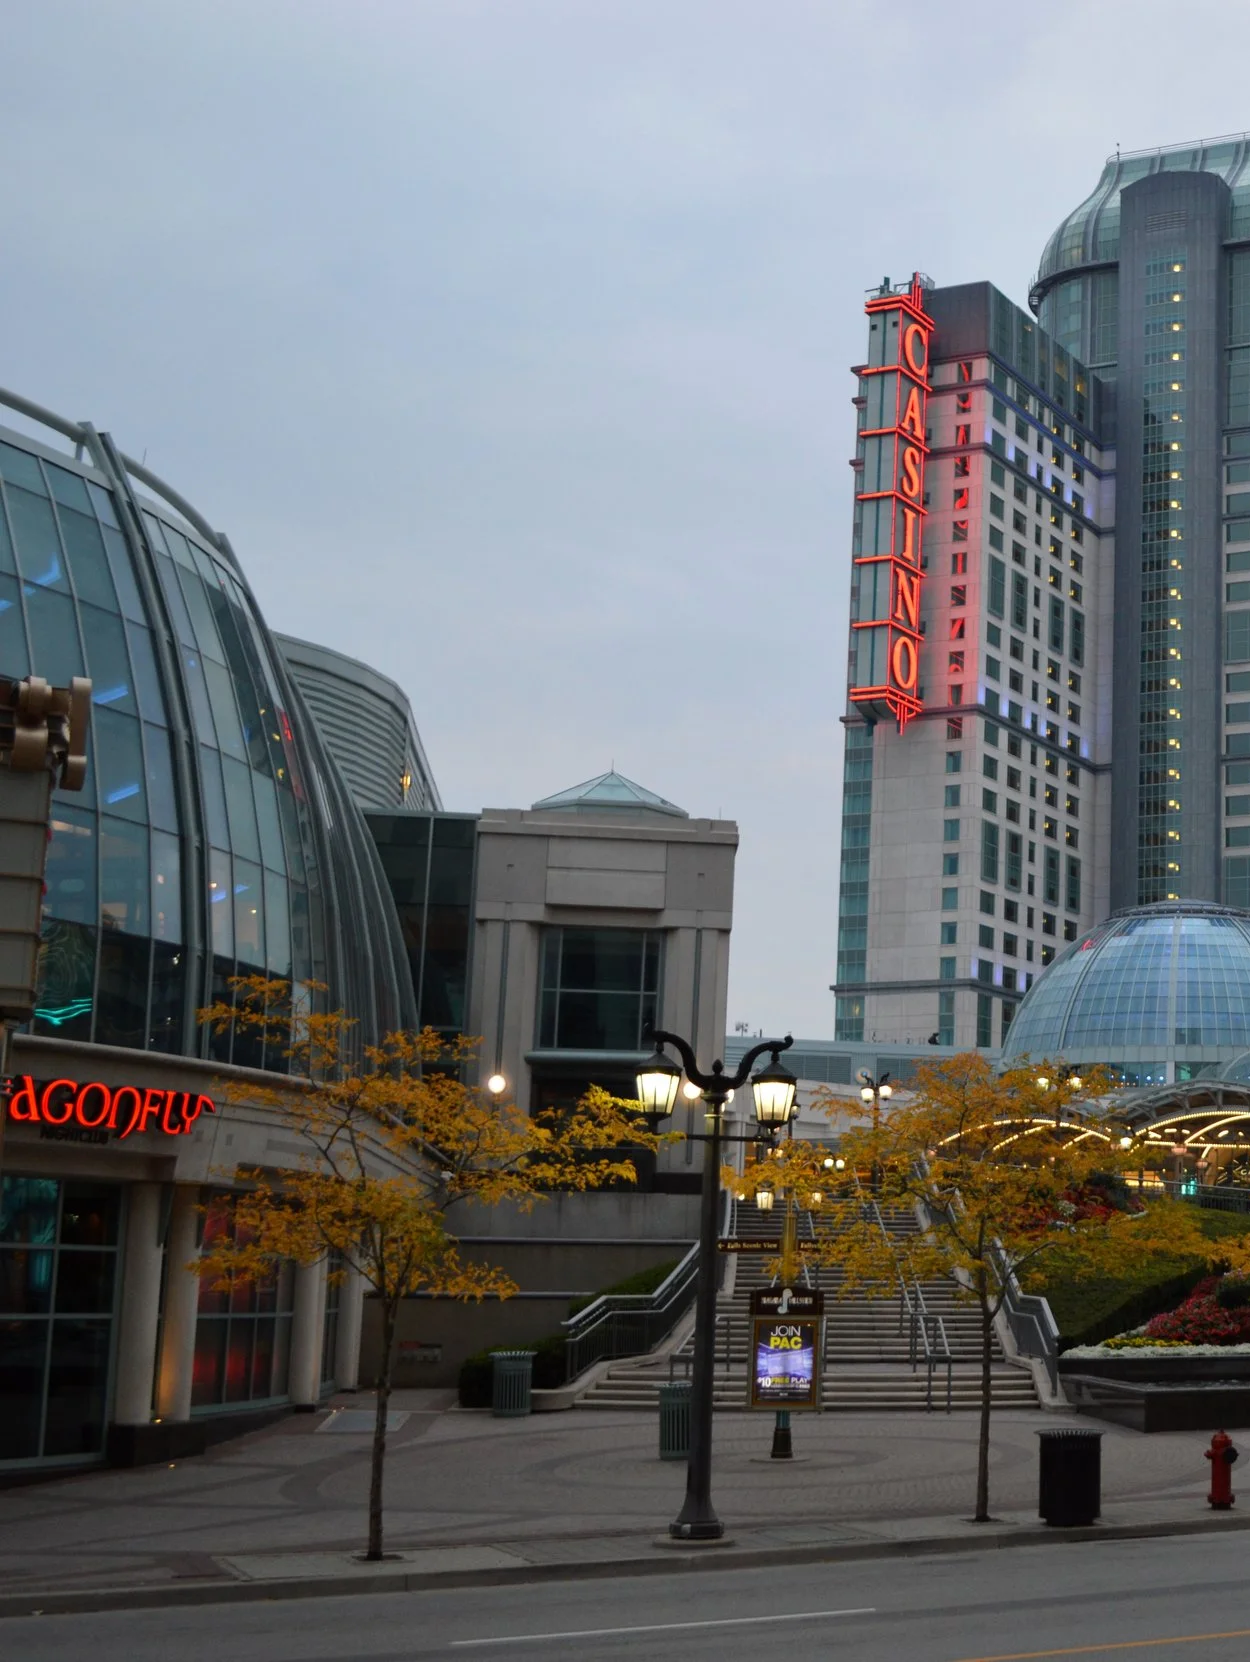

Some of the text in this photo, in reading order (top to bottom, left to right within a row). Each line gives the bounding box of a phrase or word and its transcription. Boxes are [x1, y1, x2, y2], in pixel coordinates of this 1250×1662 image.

[892, 323, 927, 691] CASINO
[6, 1074, 216, 1140] AGONFLY
[770, 1325, 801, 1336] JOIN
[770, 1336, 802, 1350] PAC
